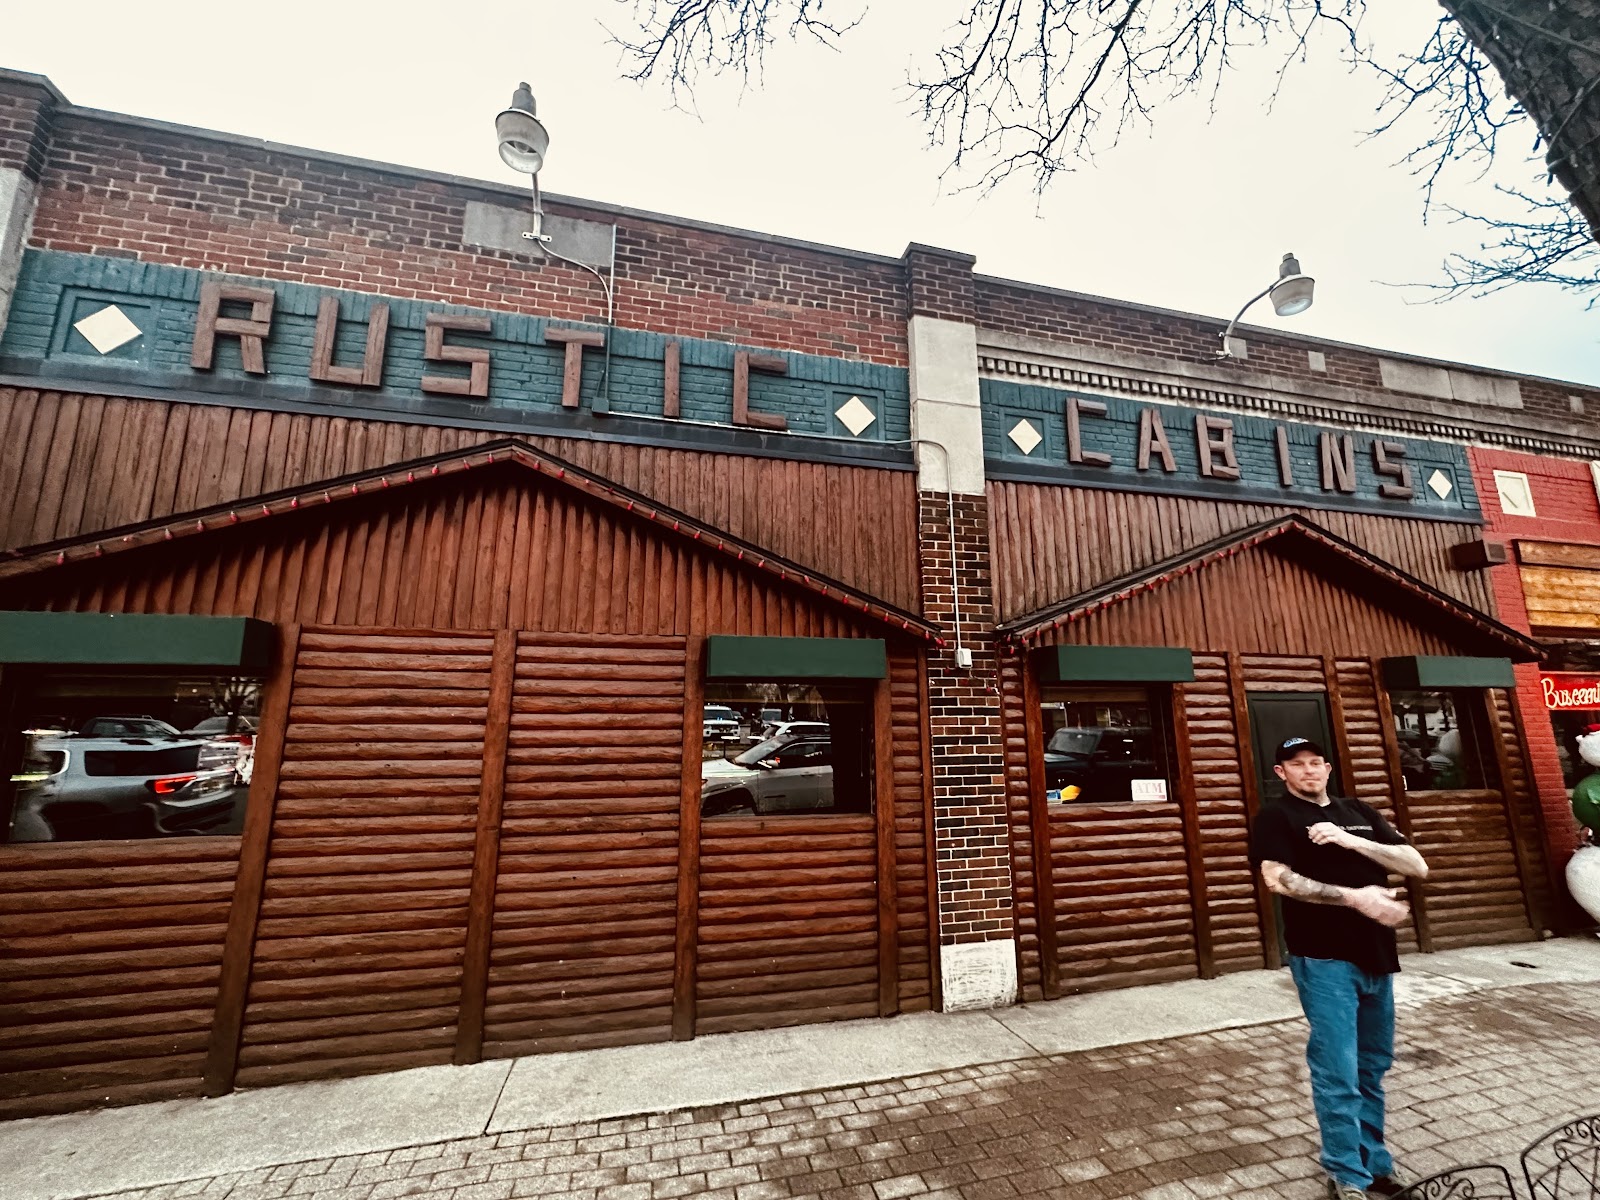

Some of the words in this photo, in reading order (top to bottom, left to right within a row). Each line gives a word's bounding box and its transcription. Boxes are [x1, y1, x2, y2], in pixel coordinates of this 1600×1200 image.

[190, 281, 788, 431] RUSTIC
[1066, 397, 1414, 499] CABINS
[1135, 782, 1163, 794] ATM
